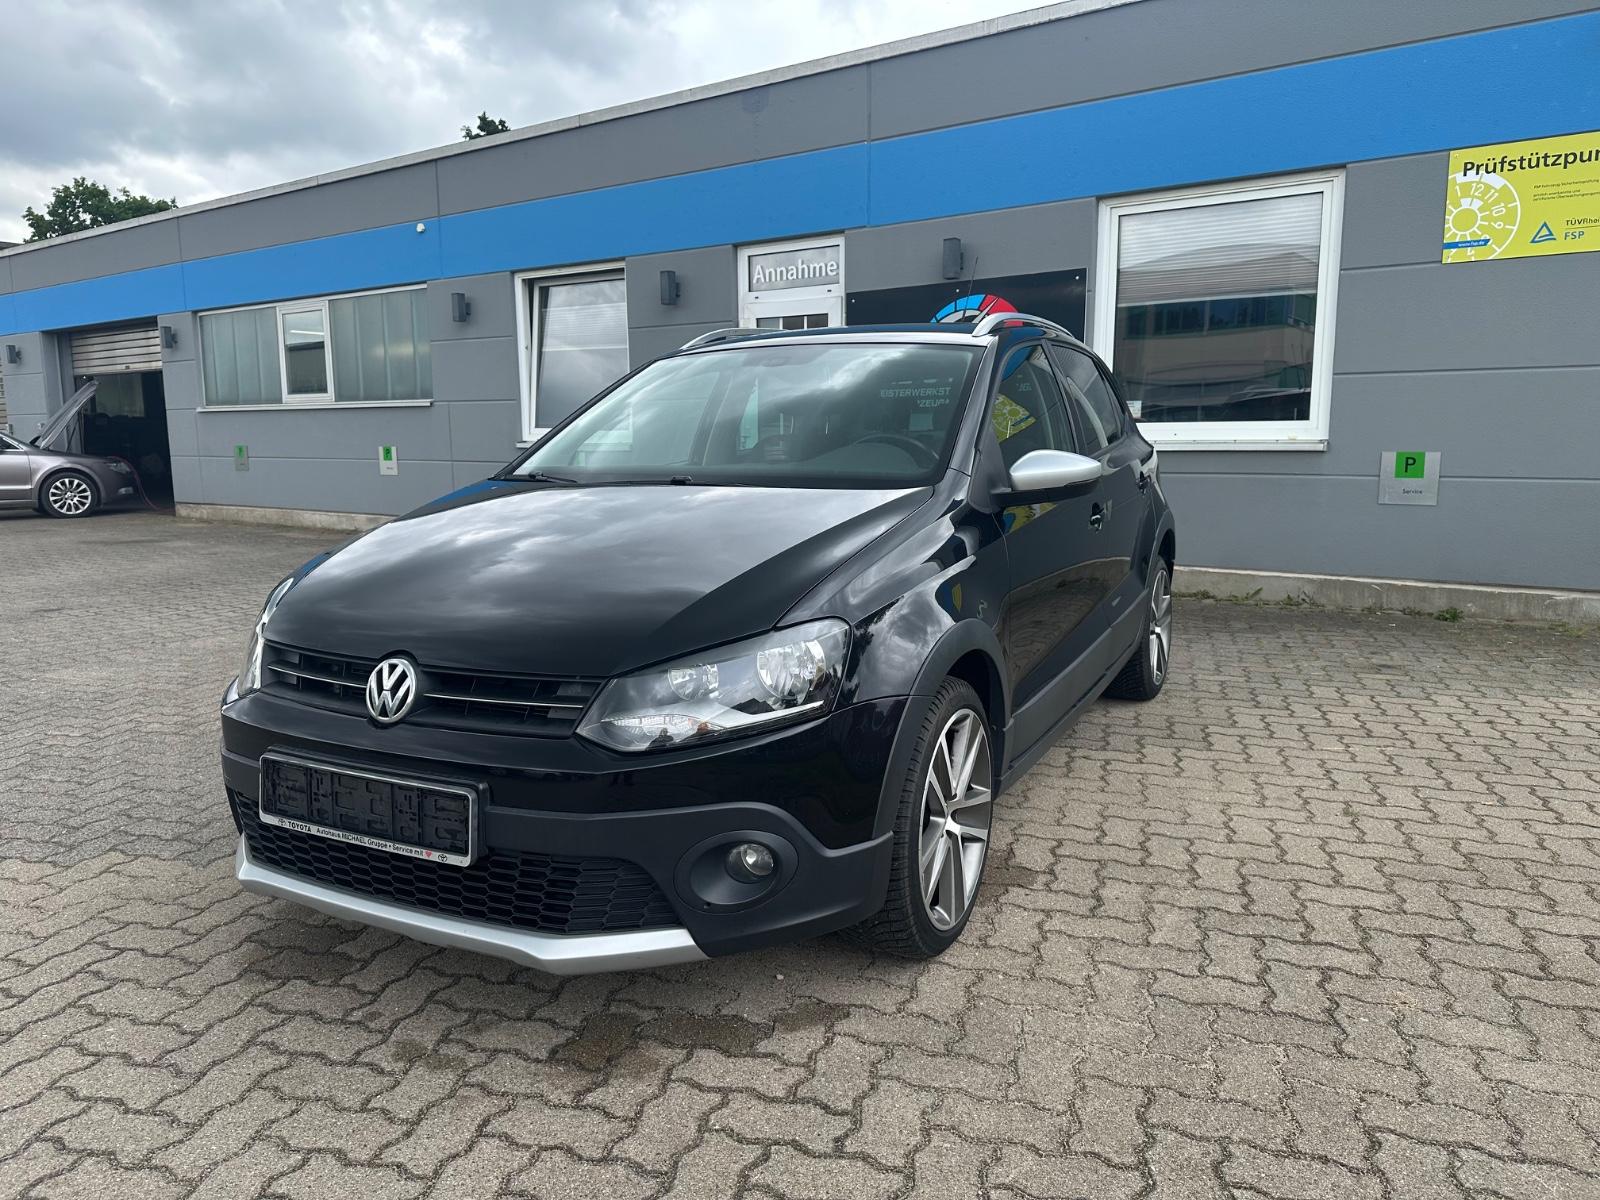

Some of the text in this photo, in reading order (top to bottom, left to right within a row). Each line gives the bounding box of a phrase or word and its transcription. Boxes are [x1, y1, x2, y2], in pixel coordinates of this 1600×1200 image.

[1564, 231, 1584, 240] FSP
[753, 259, 837, 283] Annahme
[1404, 456, 1416, 472] P
[287, 821, 312, 833] TOYOTA
[316, 827, 341, 838] Autohaus
[342, 832, 366, 844] MICHAEL
[367, 838, 389, 849] Gruppe
[392, 843, 413, 854] Service
